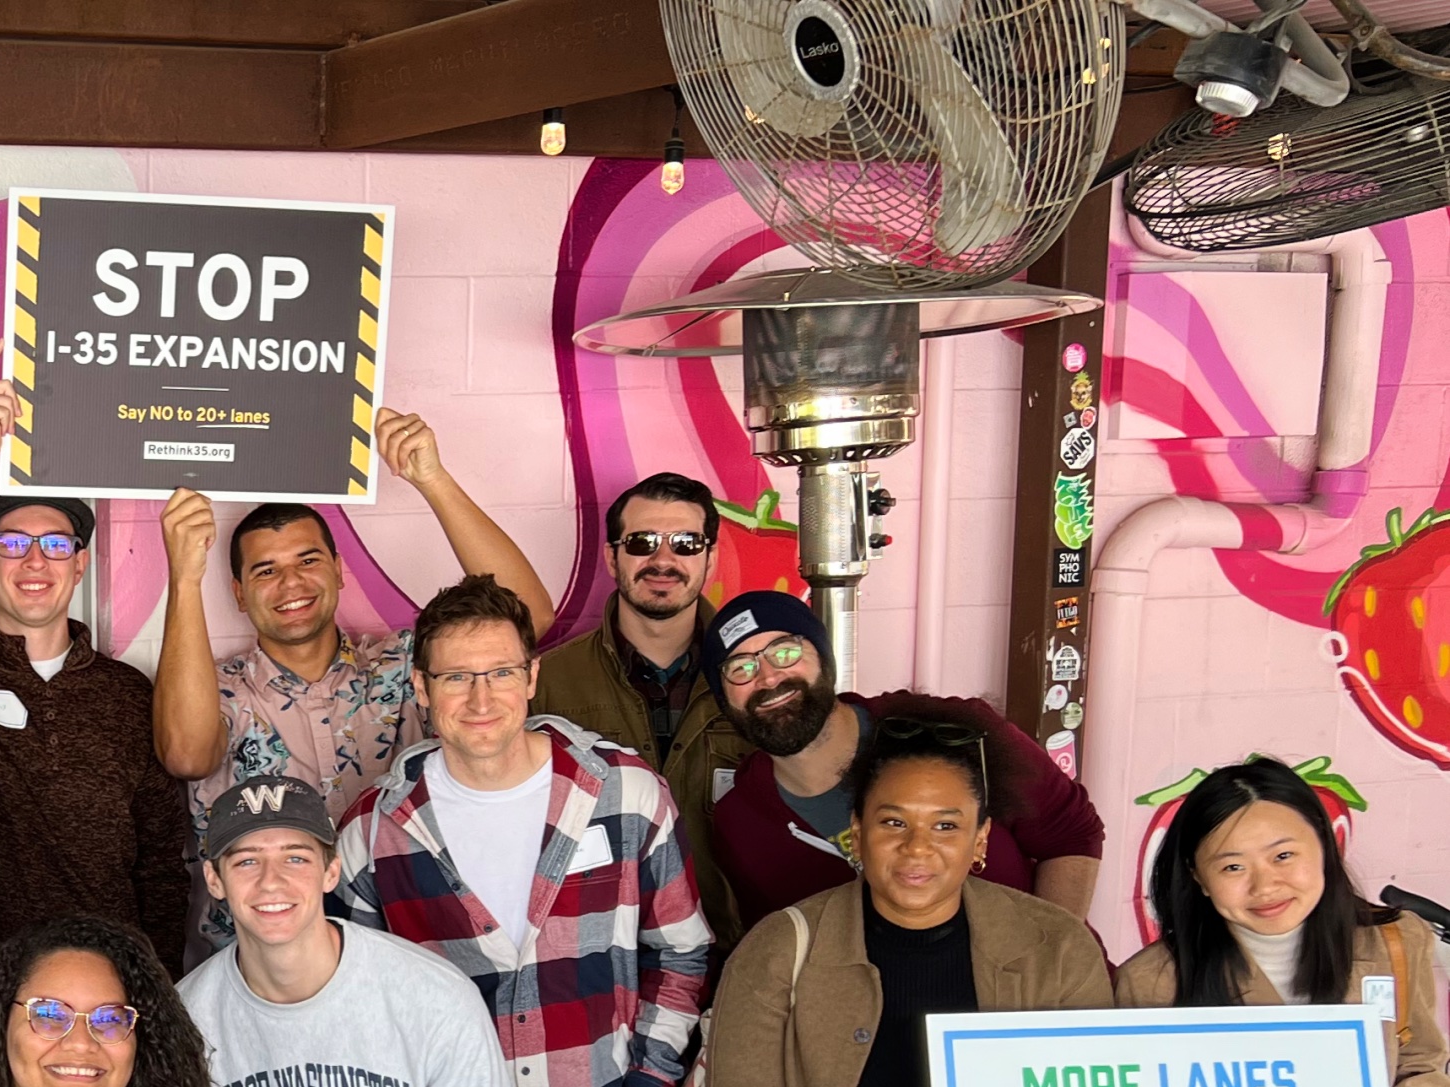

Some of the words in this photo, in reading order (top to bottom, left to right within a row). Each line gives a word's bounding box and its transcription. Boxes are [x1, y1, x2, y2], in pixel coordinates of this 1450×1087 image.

[800, 42, 839, 59] Lasko
[92, 248, 309, 322] STOP
[46, 330, 118, 366] I-35
[128, 333, 346, 374] EXPANSION
[117, 405, 146, 423] Say
[150, 405, 174, 421] NO
[177, 407, 193, 422] to
[196, 407, 227, 423] 20+
[230, 408, 271, 424] lanes
[147, 444, 231, 460] Rethink35.org
[1059, 553, 1079, 563] SYM
[1059, 563, 1079, 573] PHO
[1059, 573, 1079, 583] NIC
[241, 785, 286, 815] W
